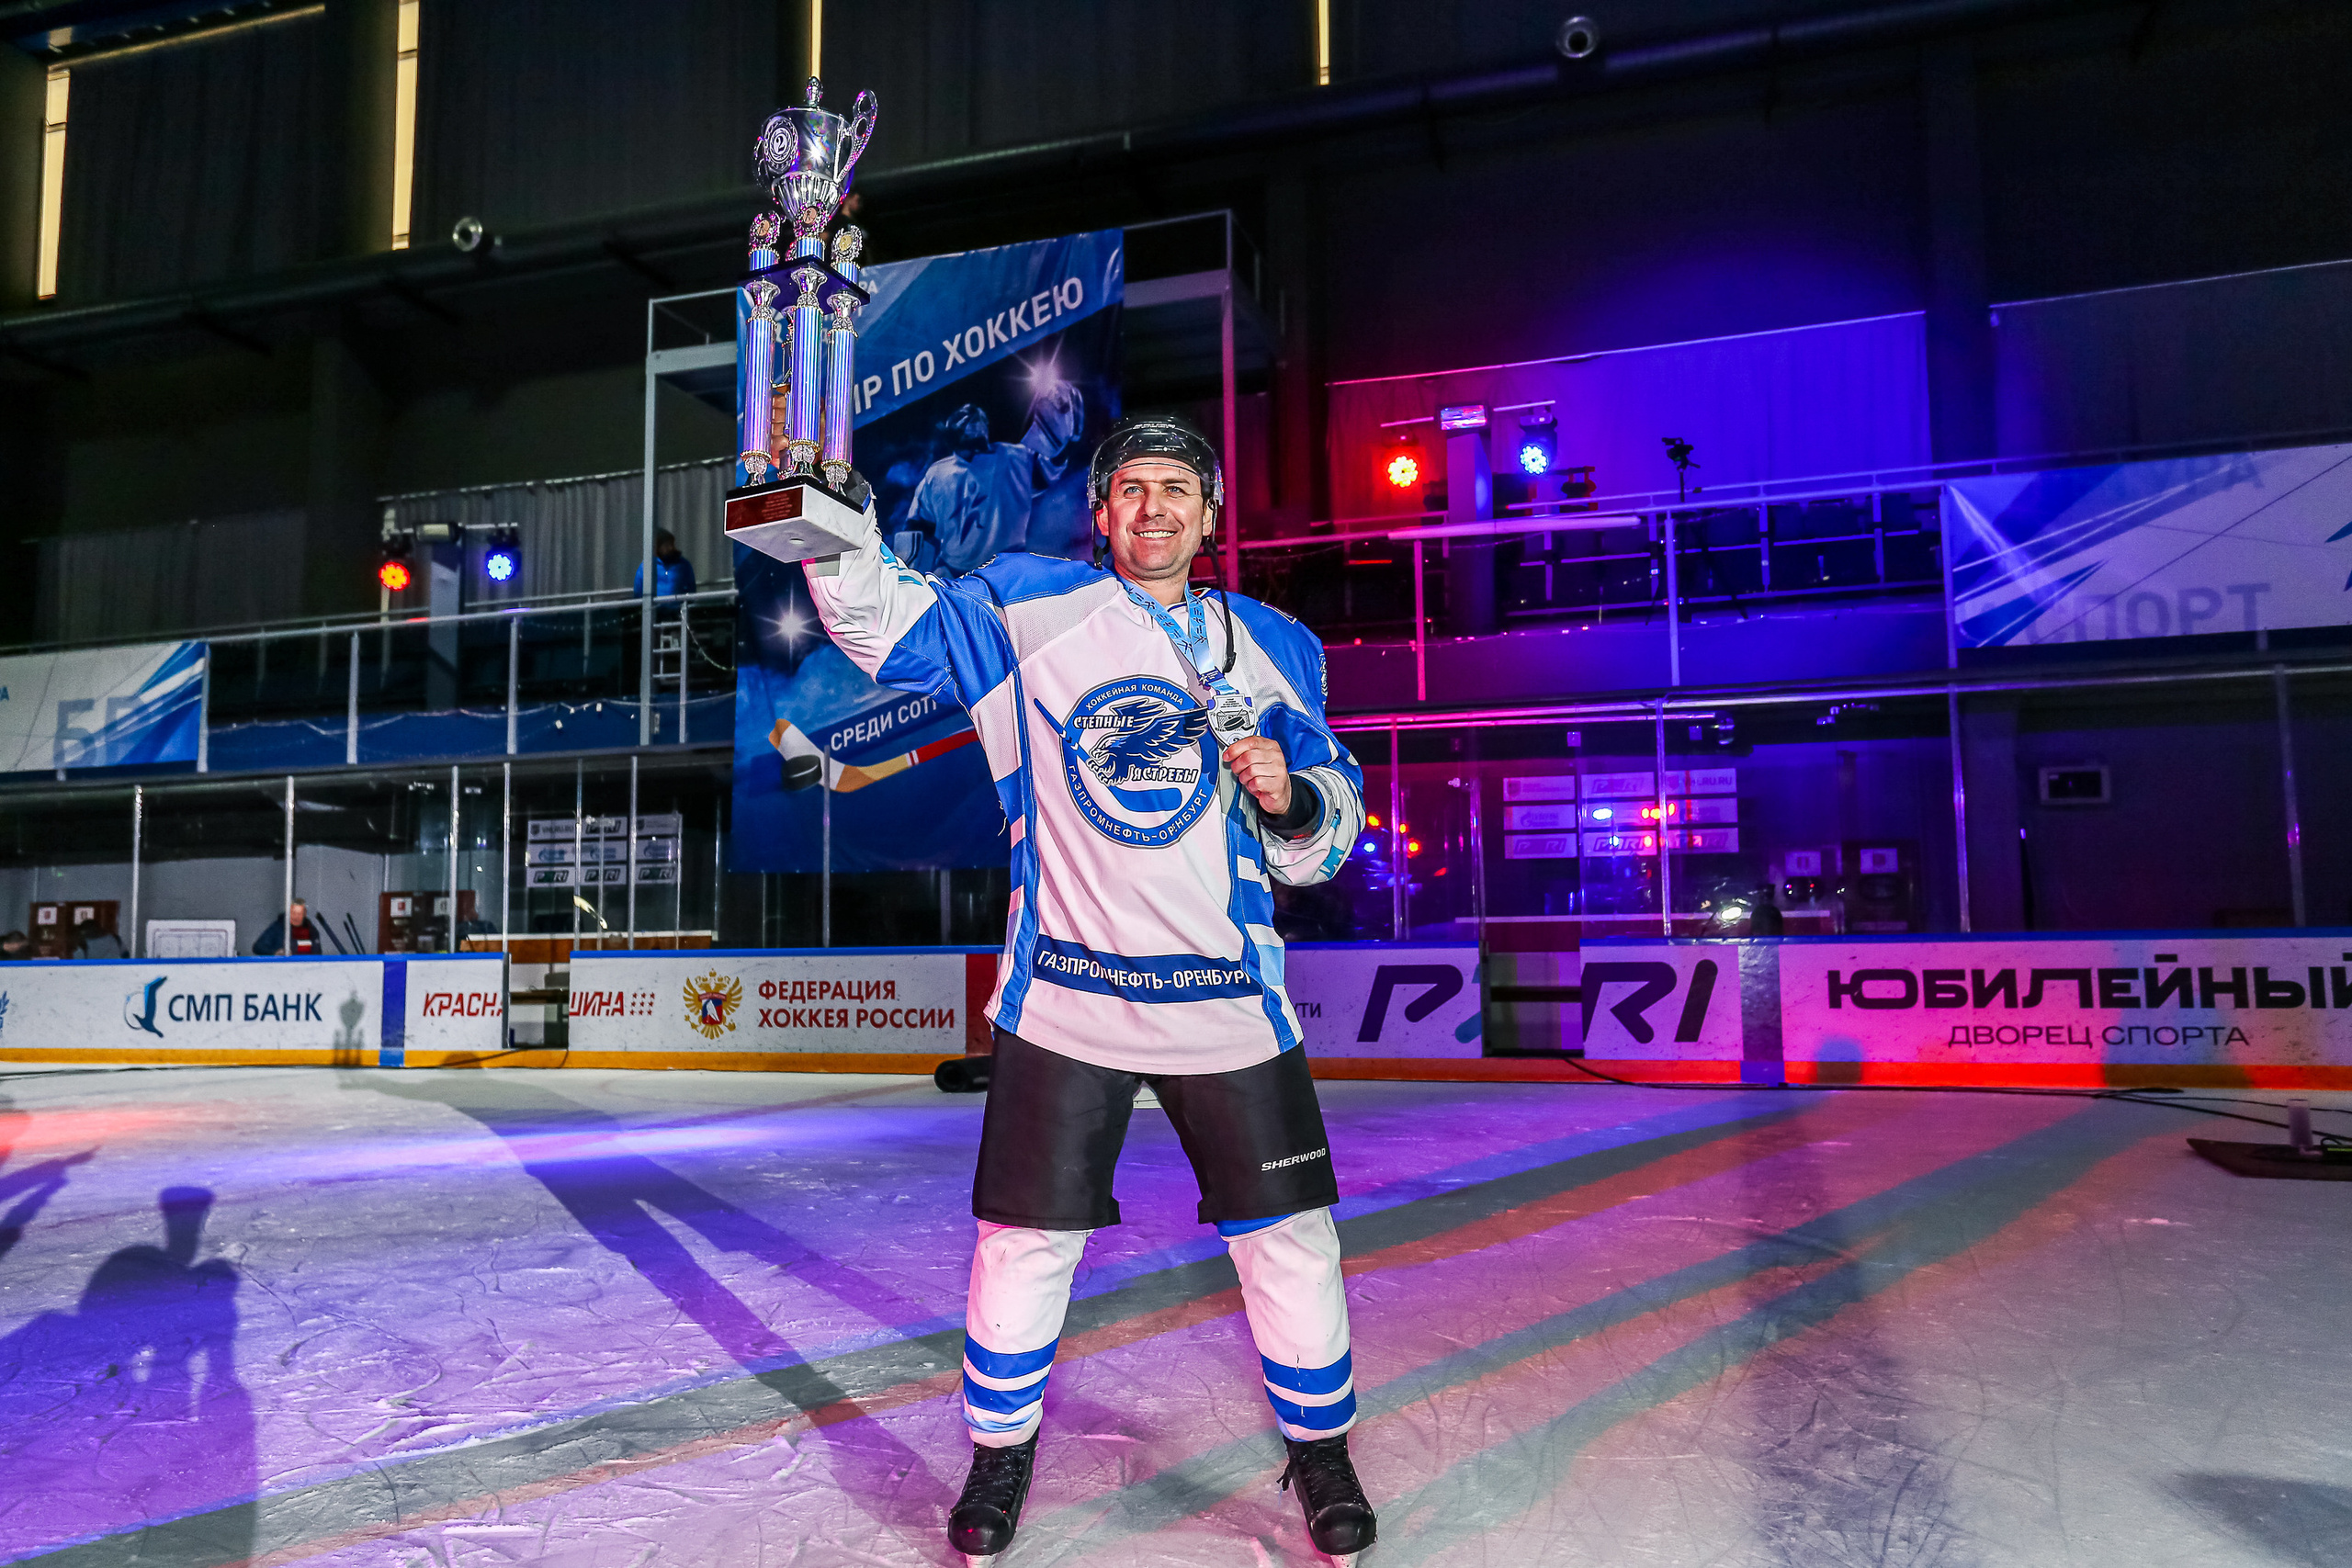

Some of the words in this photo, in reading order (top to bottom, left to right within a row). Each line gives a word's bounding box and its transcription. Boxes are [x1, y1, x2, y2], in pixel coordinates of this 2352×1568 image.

[775, 136, 786, 152] 2
[858, 279, 878, 294] РА
[890, 350, 935, 397] ПО
[943, 276, 1084, 371] ХОККЕЮ
[1086, 684, 1137, 711] ХОККЕЙНАЯ
[1141, 683, 1184, 705] КОМАНДА
[830, 711, 893, 751] СРЕДИ
[1073, 715, 1135, 729] СТЕПНЫЕ
[1132, 767, 1200, 783] ЯСТРЕБЫ
[535, 870, 569, 883] PRI
[585, 869, 620, 882] PRI
[639, 867, 674, 880] PRI
[758, 979, 897, 1003] ФЕДЕРАЦИЯ
[168, 993, 232, 1021] СМП
[243, 992, 323, 1021] БАНК
[569, 991, 625, 1016] ШИНА
[758, 1008, 849, 1028] ХОККЕЯ
[855, 1008, 955, 1029] РОССИИ
[1948, 1025, 2093, 1048] ДВОРЕЦ
[2101, 1025, 2250, 1047] СПОРТА
[1261, 1147, 1326, 1171] SHERWOOD
